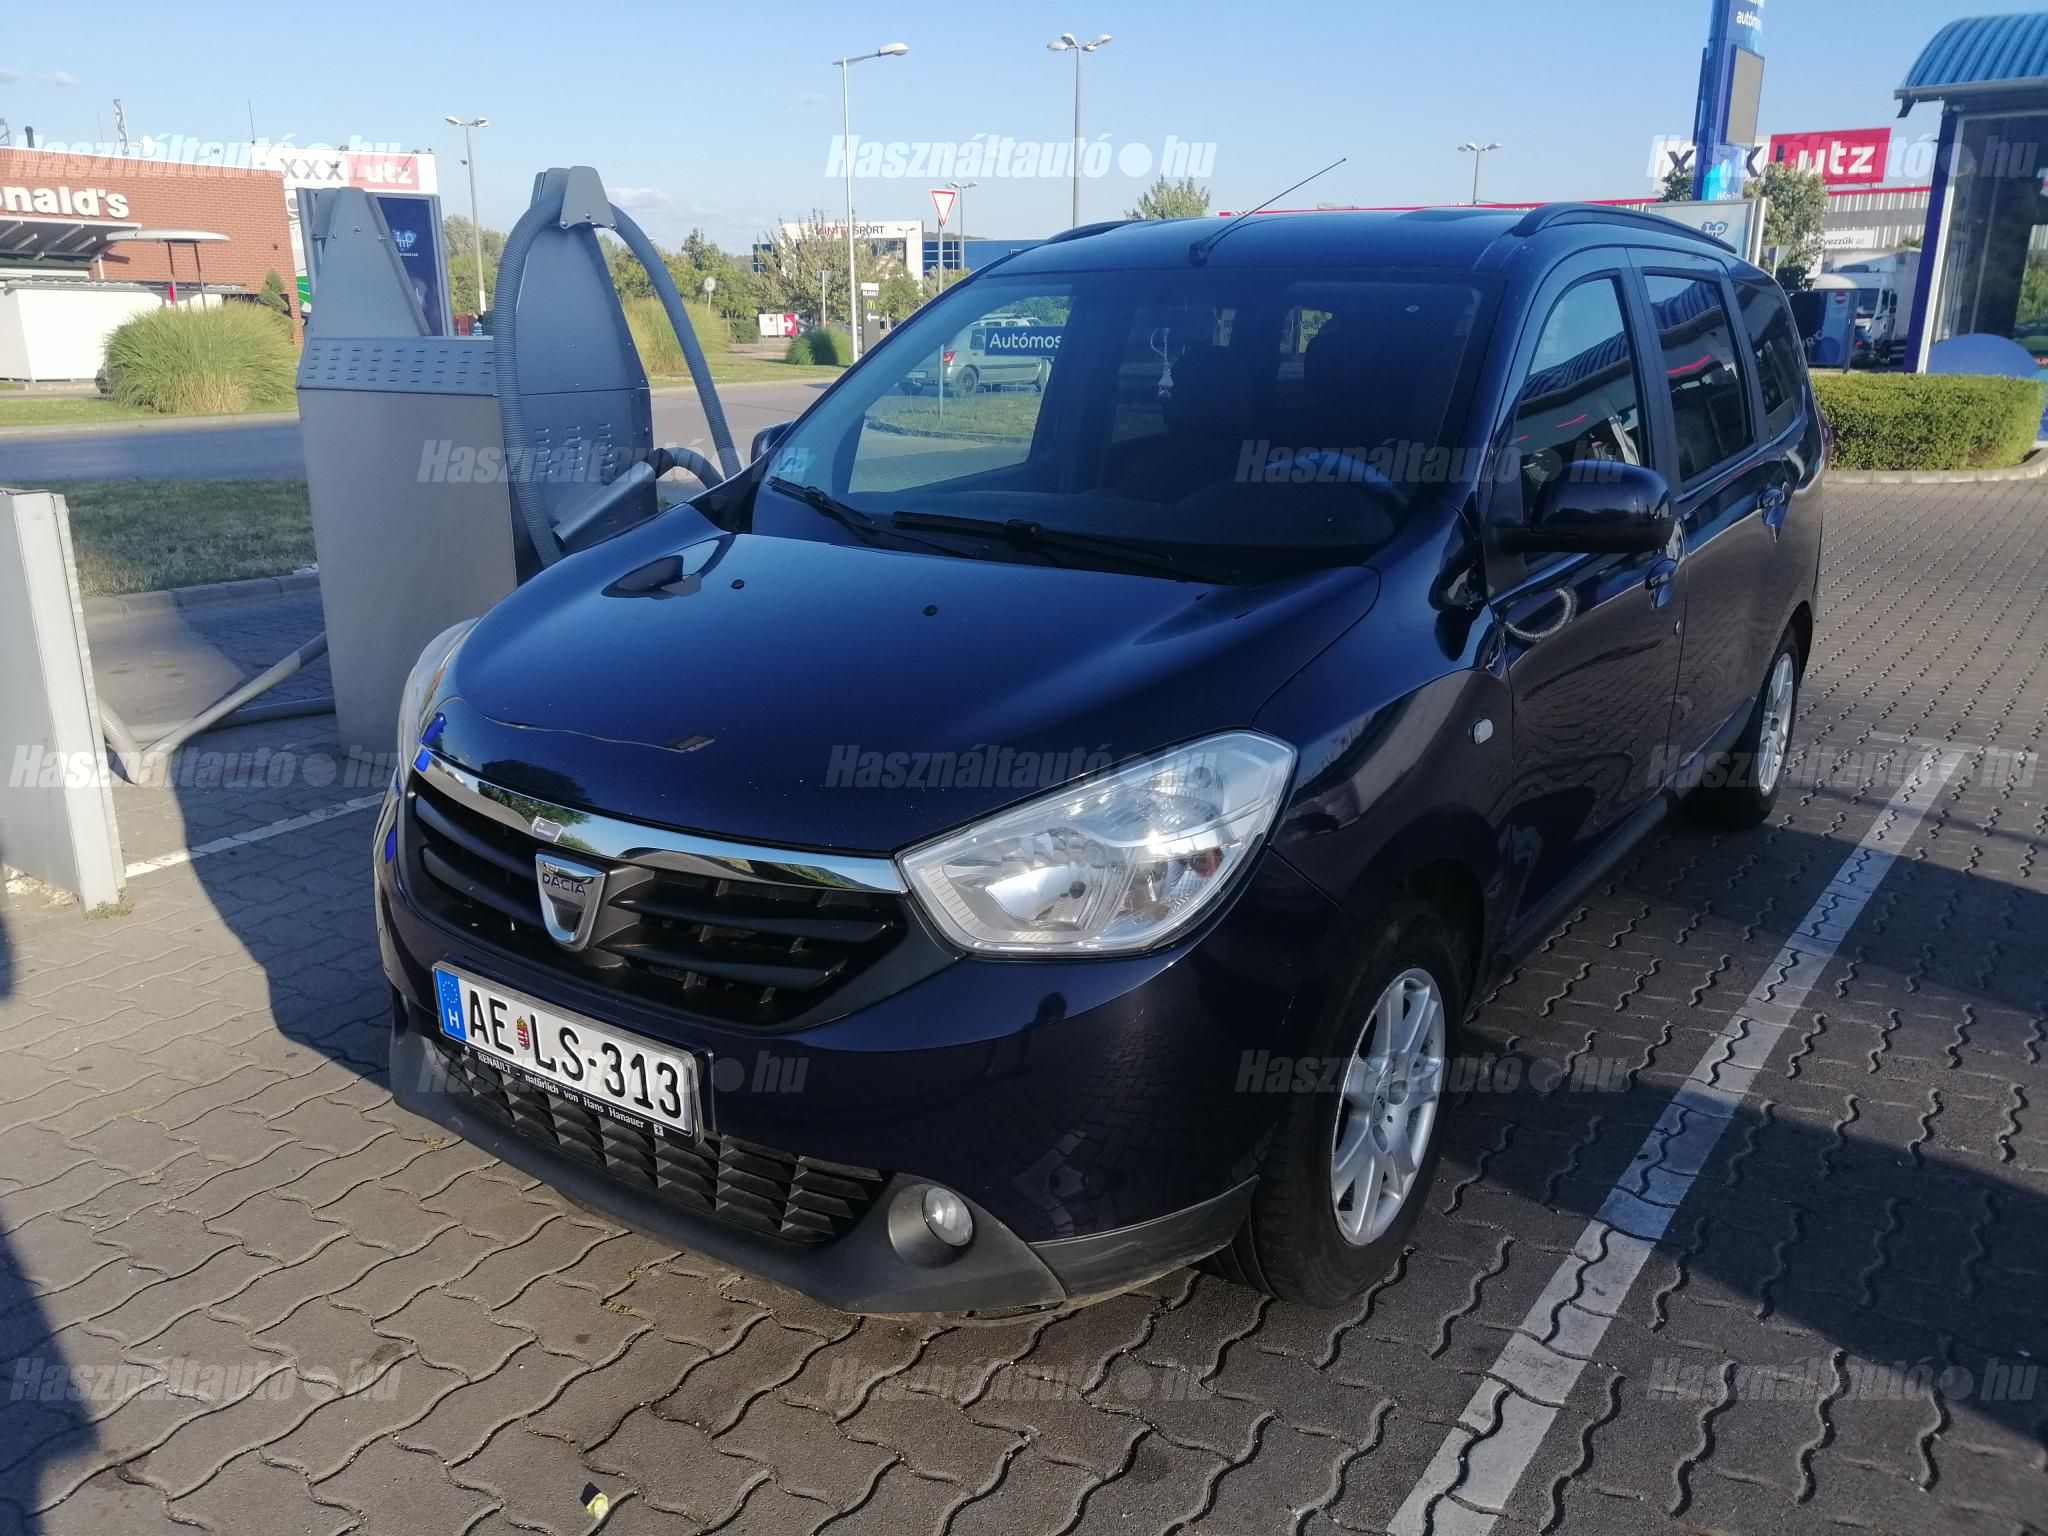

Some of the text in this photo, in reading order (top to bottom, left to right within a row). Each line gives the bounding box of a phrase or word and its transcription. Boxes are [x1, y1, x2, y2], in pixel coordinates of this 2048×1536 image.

[0, 186, 130, 219] nald's
[824, 225, 884, 235] INTESPORT
[542, 873, 586, 896] DACIA
[447, 1008, 460, 1029] H
[469, 989, 682, 1119] AE LS-313
[477, 1052, 511, 1074] RENAULT
[524, 1073, 559, 1095] natürlich
[563, 1092, 579, 1103] von
[583, 1097, 604, 1113] Hans
[608, 1106, 645, 1129] Hanauer
